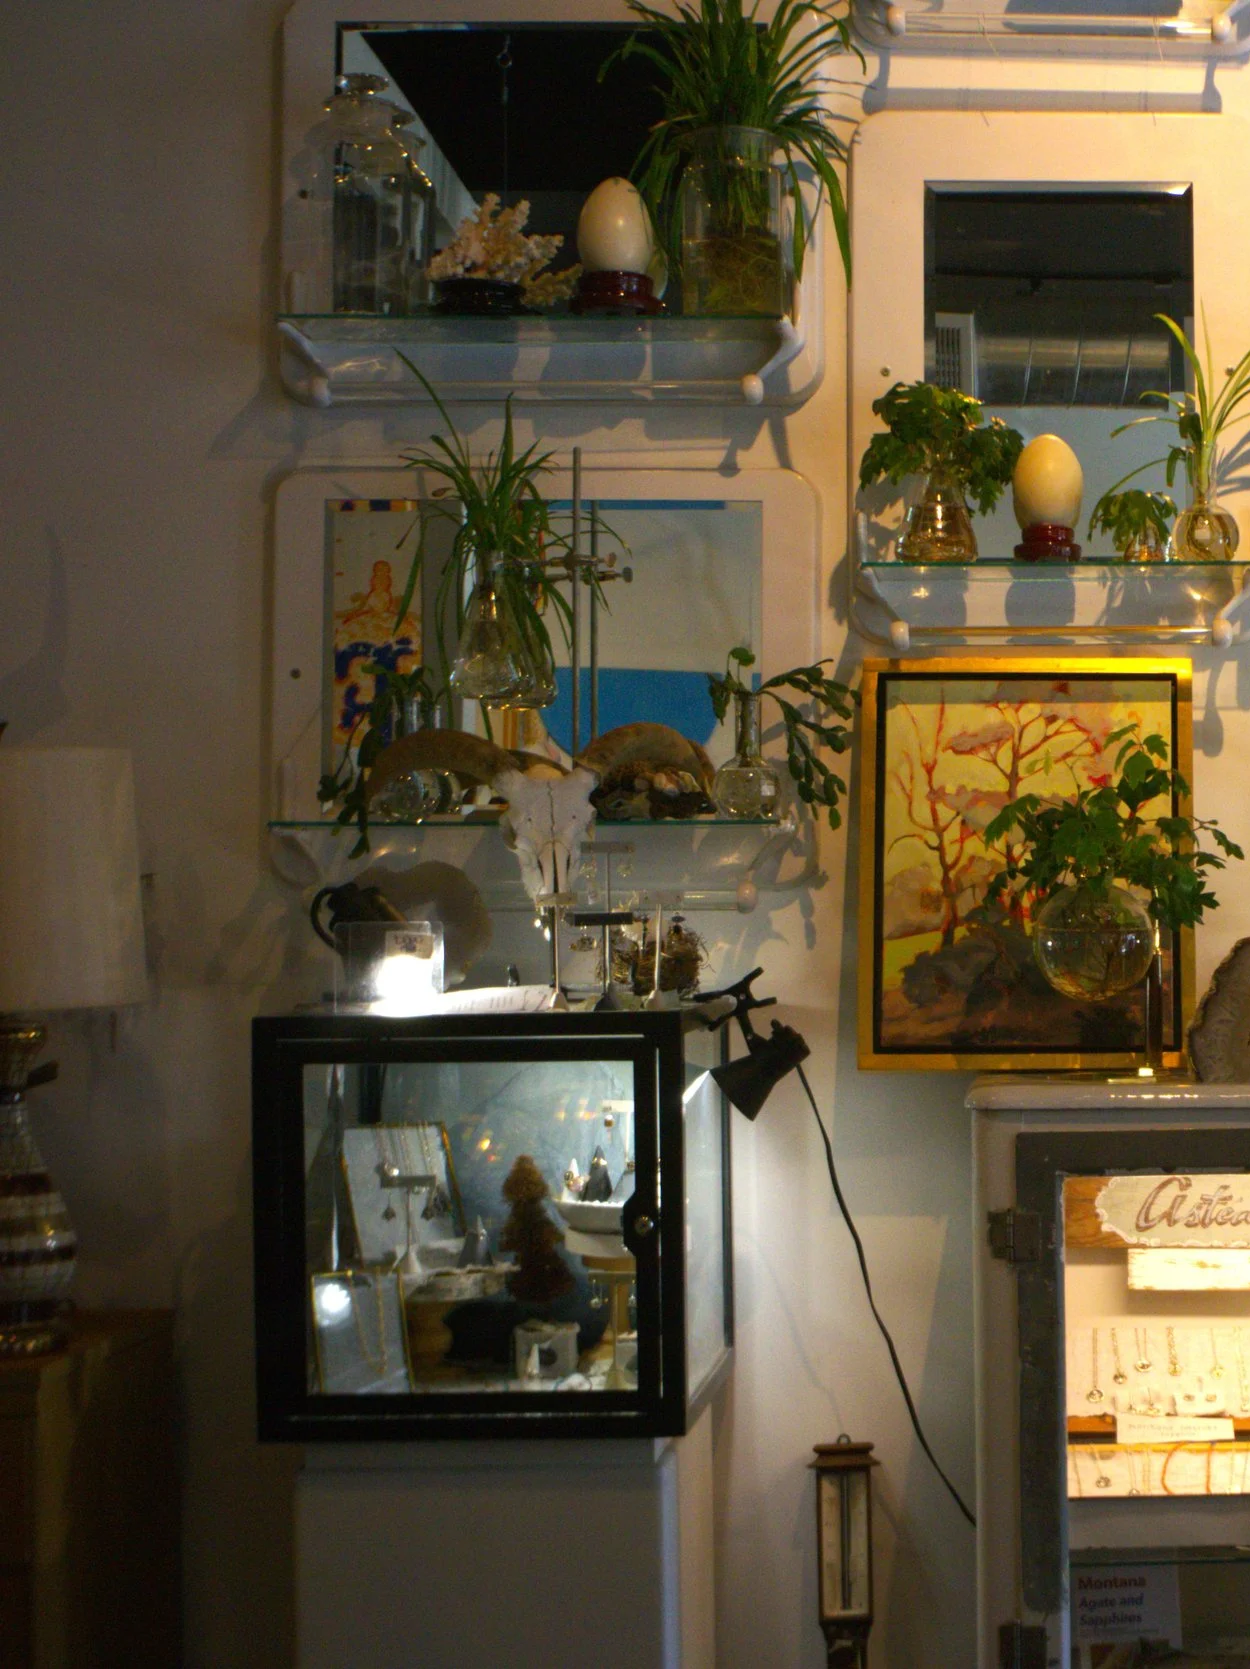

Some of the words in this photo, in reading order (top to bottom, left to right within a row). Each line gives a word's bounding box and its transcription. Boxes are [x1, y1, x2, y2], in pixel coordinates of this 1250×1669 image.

[1077, 1576, 1147, 1590] Montana
[1078, 1596, 1117, 1611] Agate
[1119, 1592, 1145, 1606] and
[1079, 1611, 1143, 1628] Sapphires
